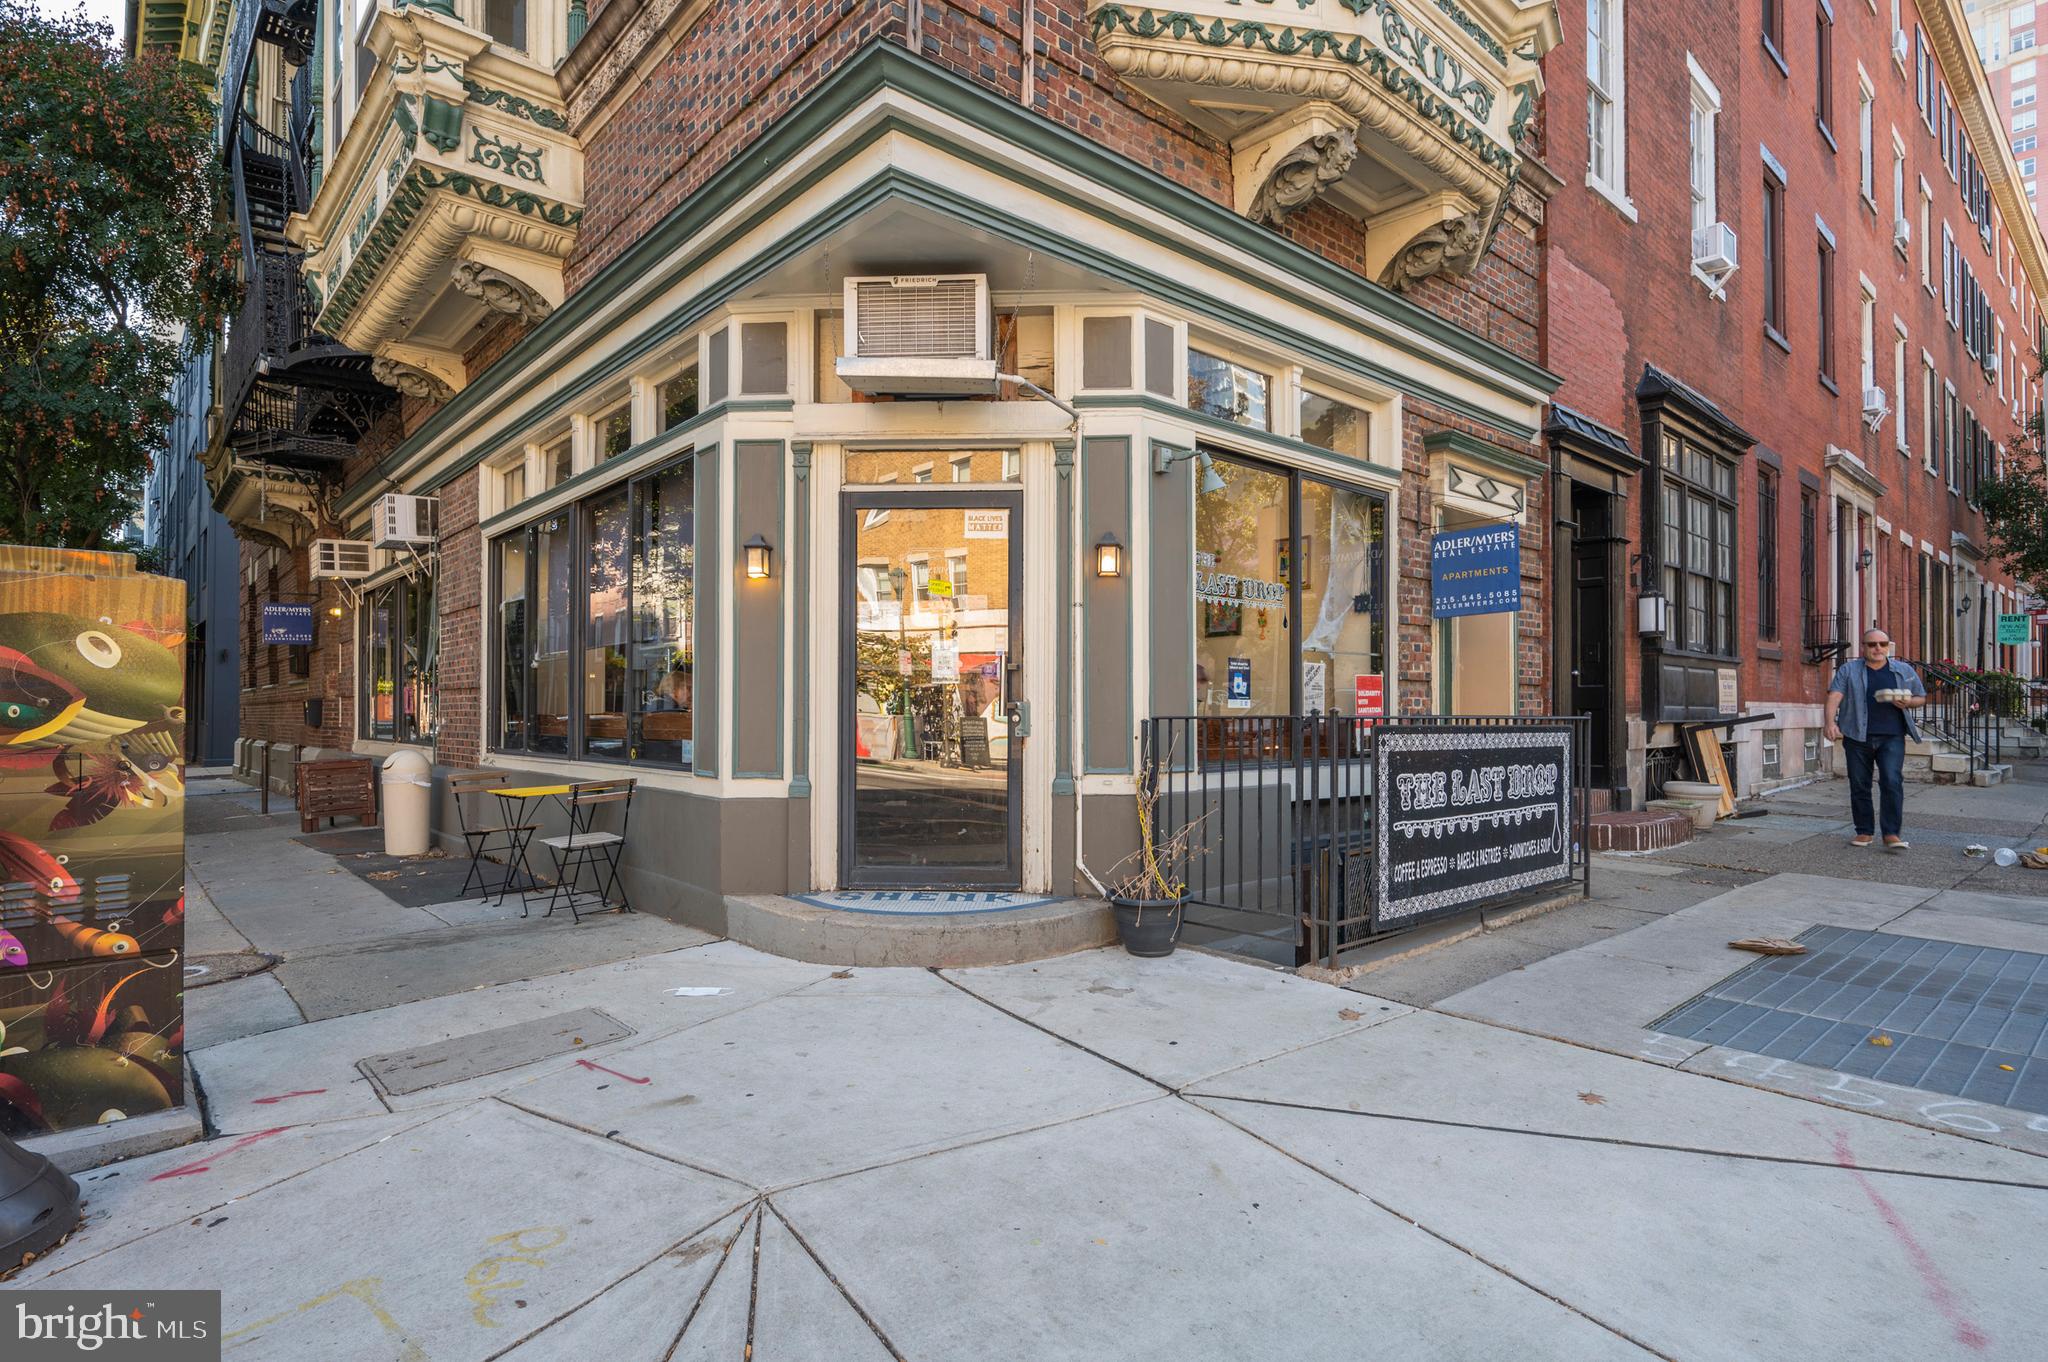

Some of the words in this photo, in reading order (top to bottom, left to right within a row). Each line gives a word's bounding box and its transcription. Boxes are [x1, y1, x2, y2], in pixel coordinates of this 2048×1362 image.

[1434, 531, 1515, 551] ADLER/MYERS
[1434, 549, 1462, 559] REAL
[1471, 542, 1515, 554] ESTATE
[1442, 566, 1509, 581] APARTMENTS
[1242, 577, 1286, 602] DROP
[1435, 589, 1517, 604] 215.545.5085
[1435, 597, 1518, 611] ADLERMYERS.COM
[1396, 772, 1447, 811] THE
[1451, 766, 1506, 806] LAST
[1507, 763, 1558, 799] DROP
[1394, 860, 1416, 883] COFFEE
[1421, 856, 1448, 878] ESPRESSO
[1457, 850, 1475, 871] BAGELS
[1480, 846, 1502, 866] PASTRIES
[1509, 840, 1537, 861] SANDWICHES
[1540, 837, 1551, 853] SOUP
[834, 891, 1013, 903] SHENK
